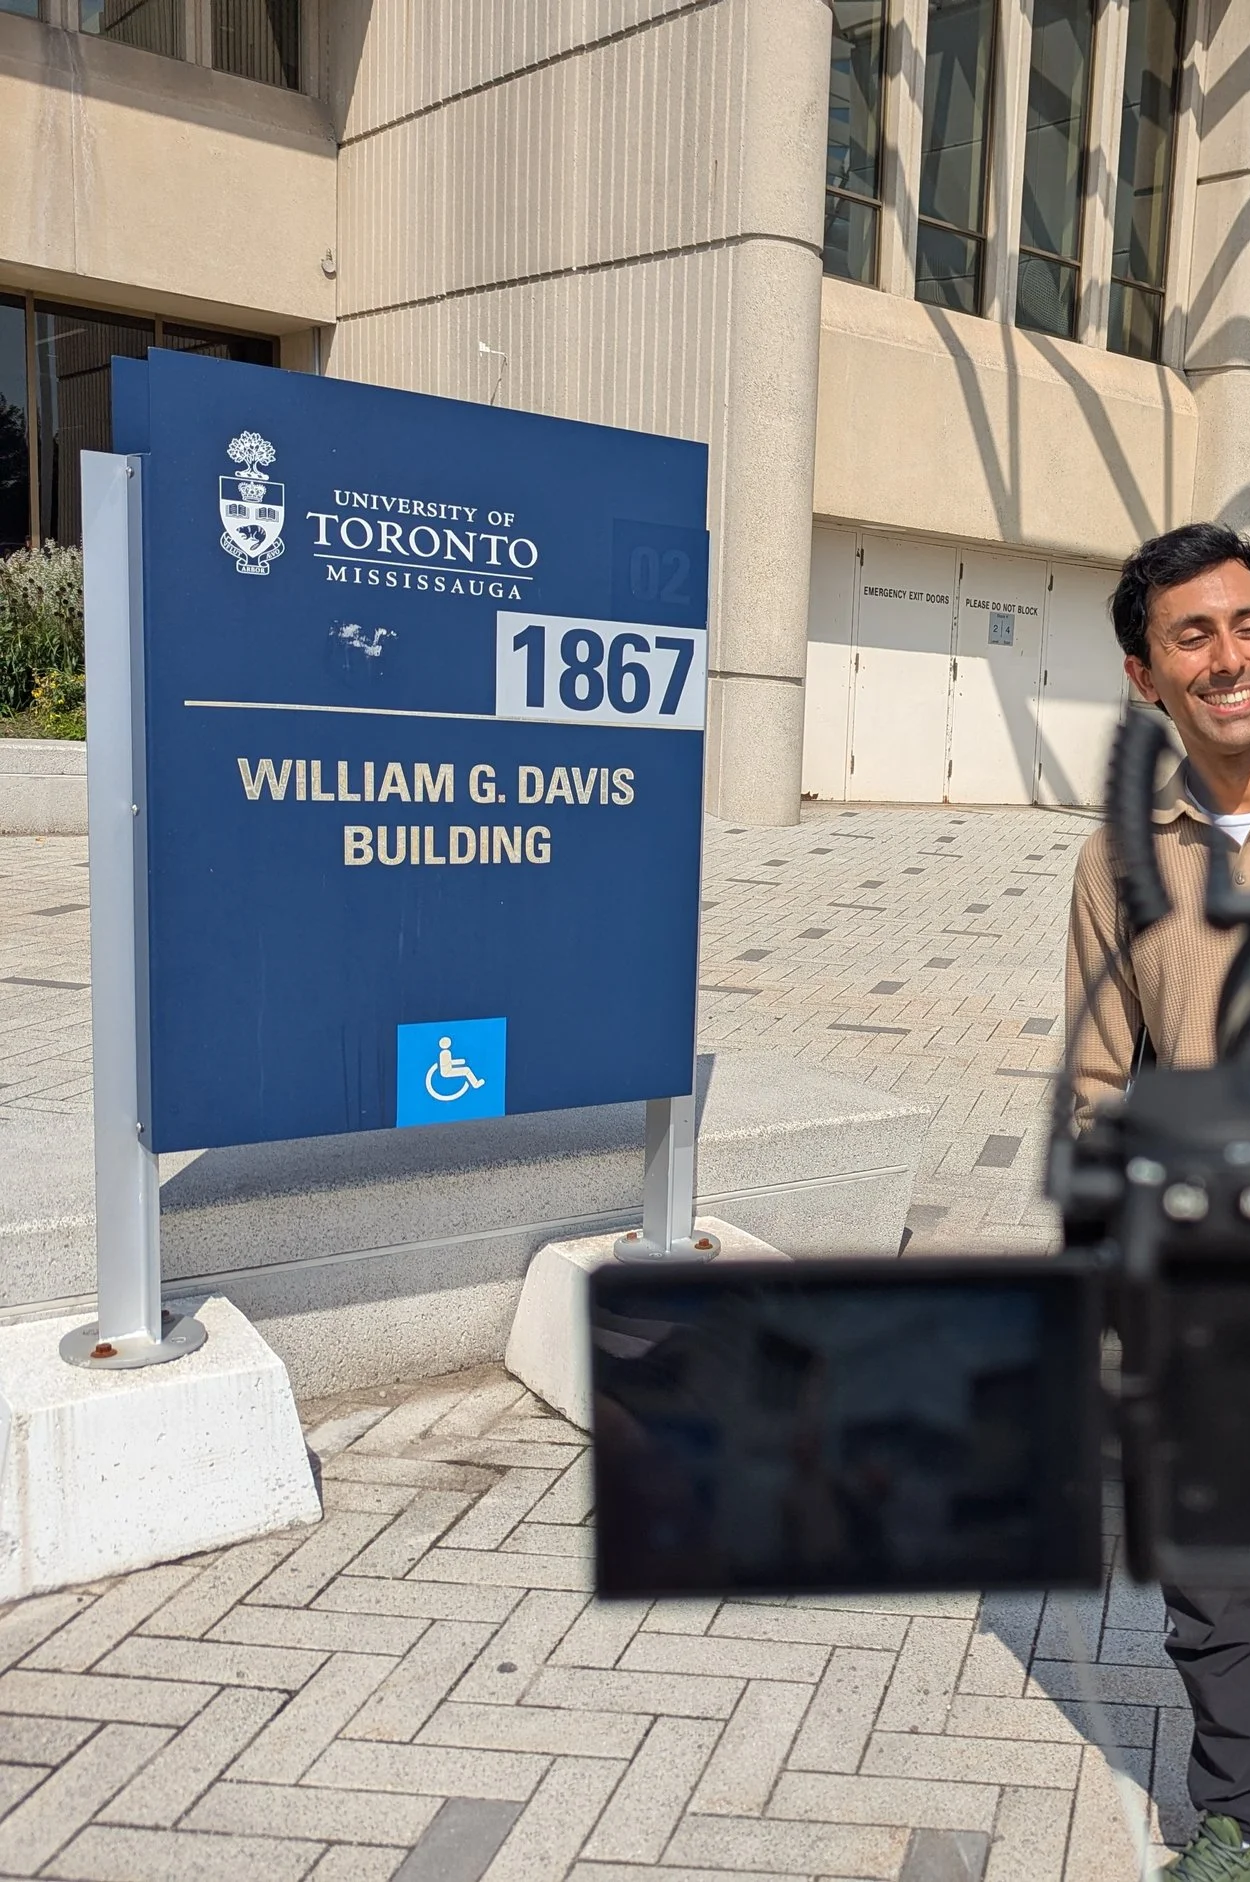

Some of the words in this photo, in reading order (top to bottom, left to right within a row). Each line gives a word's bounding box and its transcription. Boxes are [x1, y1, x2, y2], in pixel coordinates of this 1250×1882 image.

[333, 489, 478, 523] UNIVERSITY
[487, 510, 515, 528] OF
[223, 540, 243, 557] VELUT
[305, 511, 538, 569] TORONTO
[241, 565, 265, 574] ARBOR
[326, 564, 522, 600] MISSISSAUGA
[629, 545, 691, 605] 02
[863, 585, 907, 600] EMERGENCY
[909, 590, 924, 601] EXIT
[926, 592, 950, 605] DOORS
[965, 598, 990, 610] PLEASE
[991, 601, 1002, 611] DO
[1003, 603, 1016, 613] NOT
[1017, 605, 1039, 616] BLOCK
[992, 624, 999, 633] 2
[1005, 625, 1011, 635] 4
[512, 624, 695, 716] 1867
[236, 757, 455, 803] WILLIAM
[468, 763, 506, 804] G.
[517, 765, 636, 805] DAVIS
[343, 825, 552, 866] BUILDING
